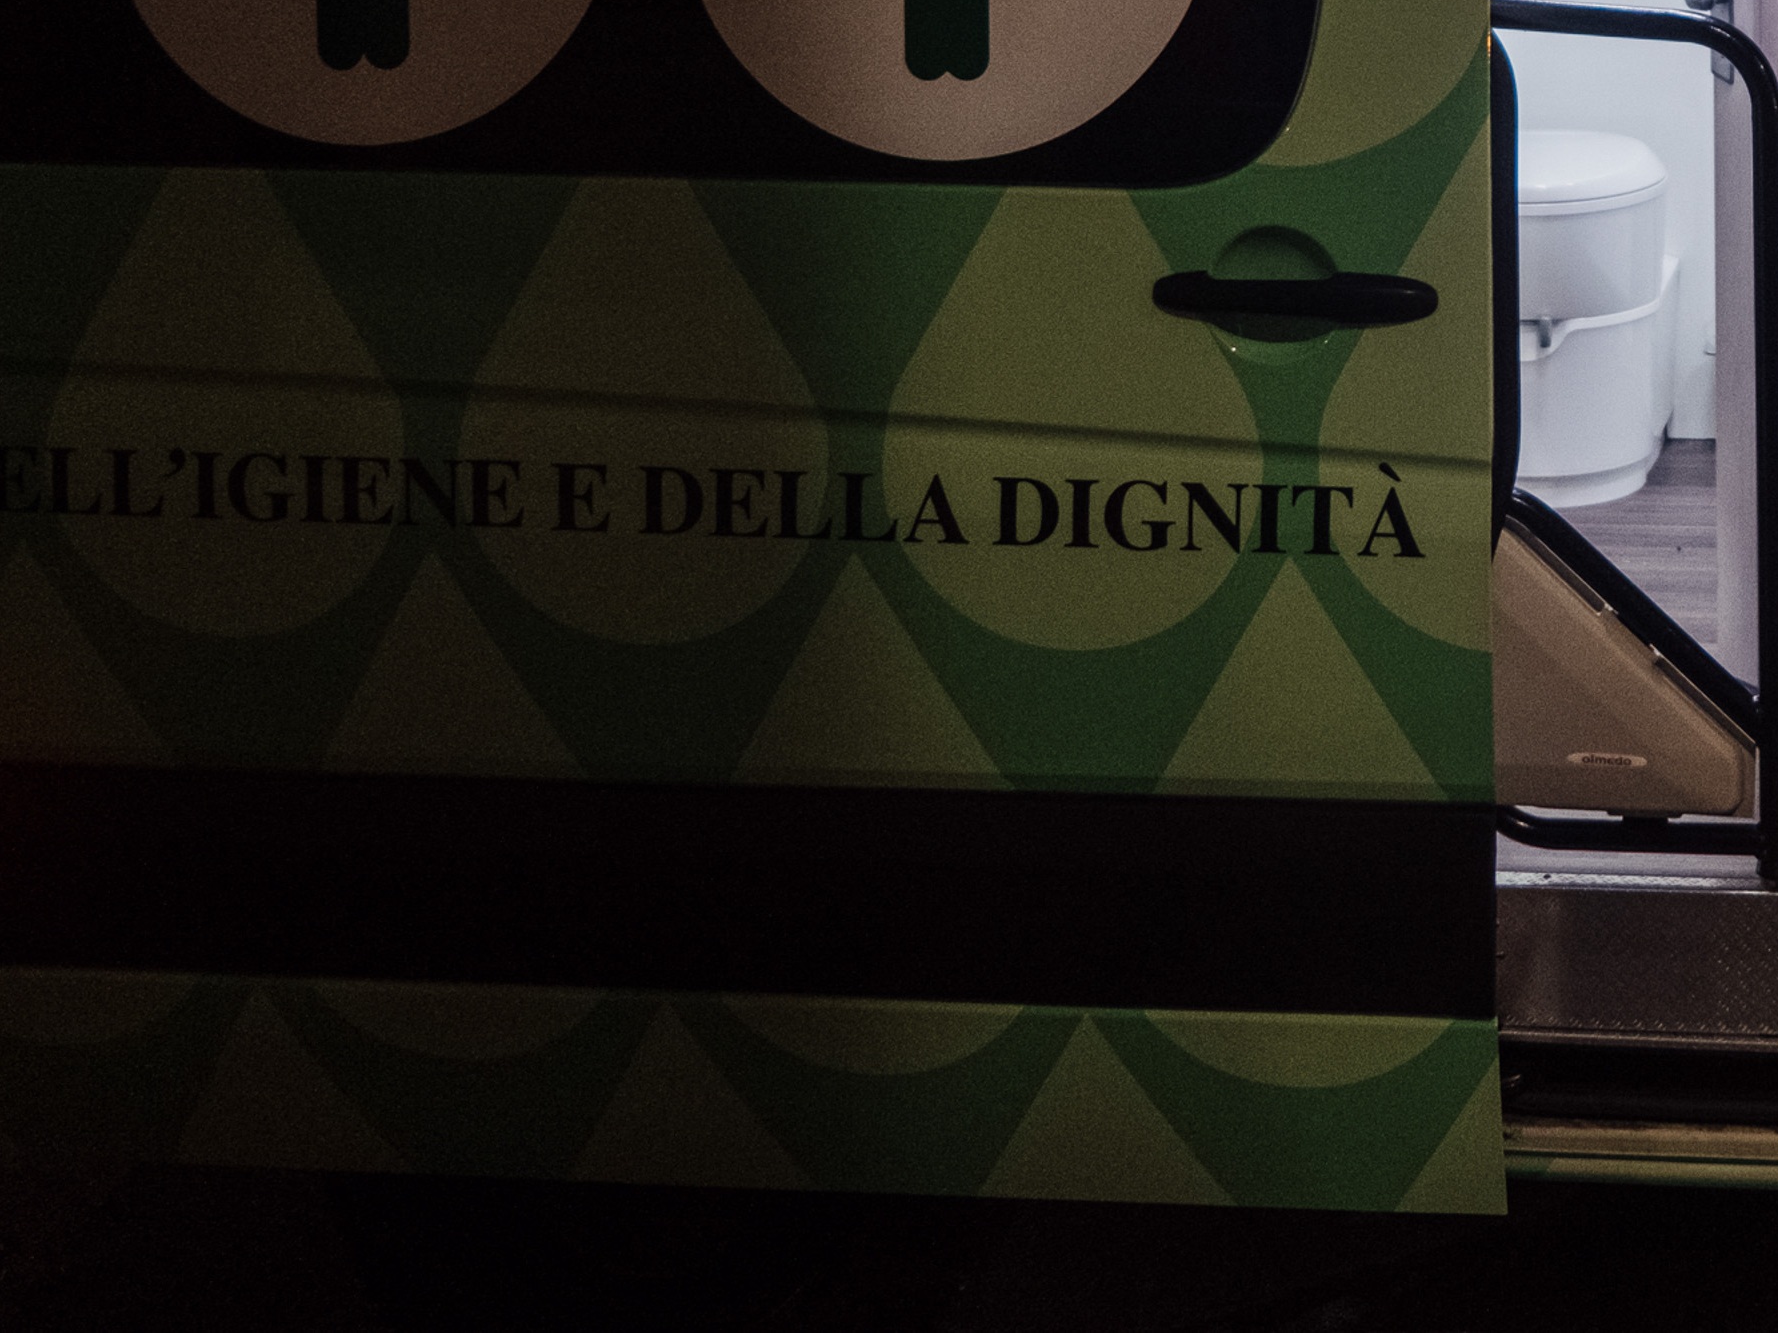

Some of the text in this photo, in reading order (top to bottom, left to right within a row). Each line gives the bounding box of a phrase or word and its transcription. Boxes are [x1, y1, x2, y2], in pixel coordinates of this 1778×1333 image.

[0, 446, 1425, 557] ELL'IGIENE E DELLA DIGNITÀ
